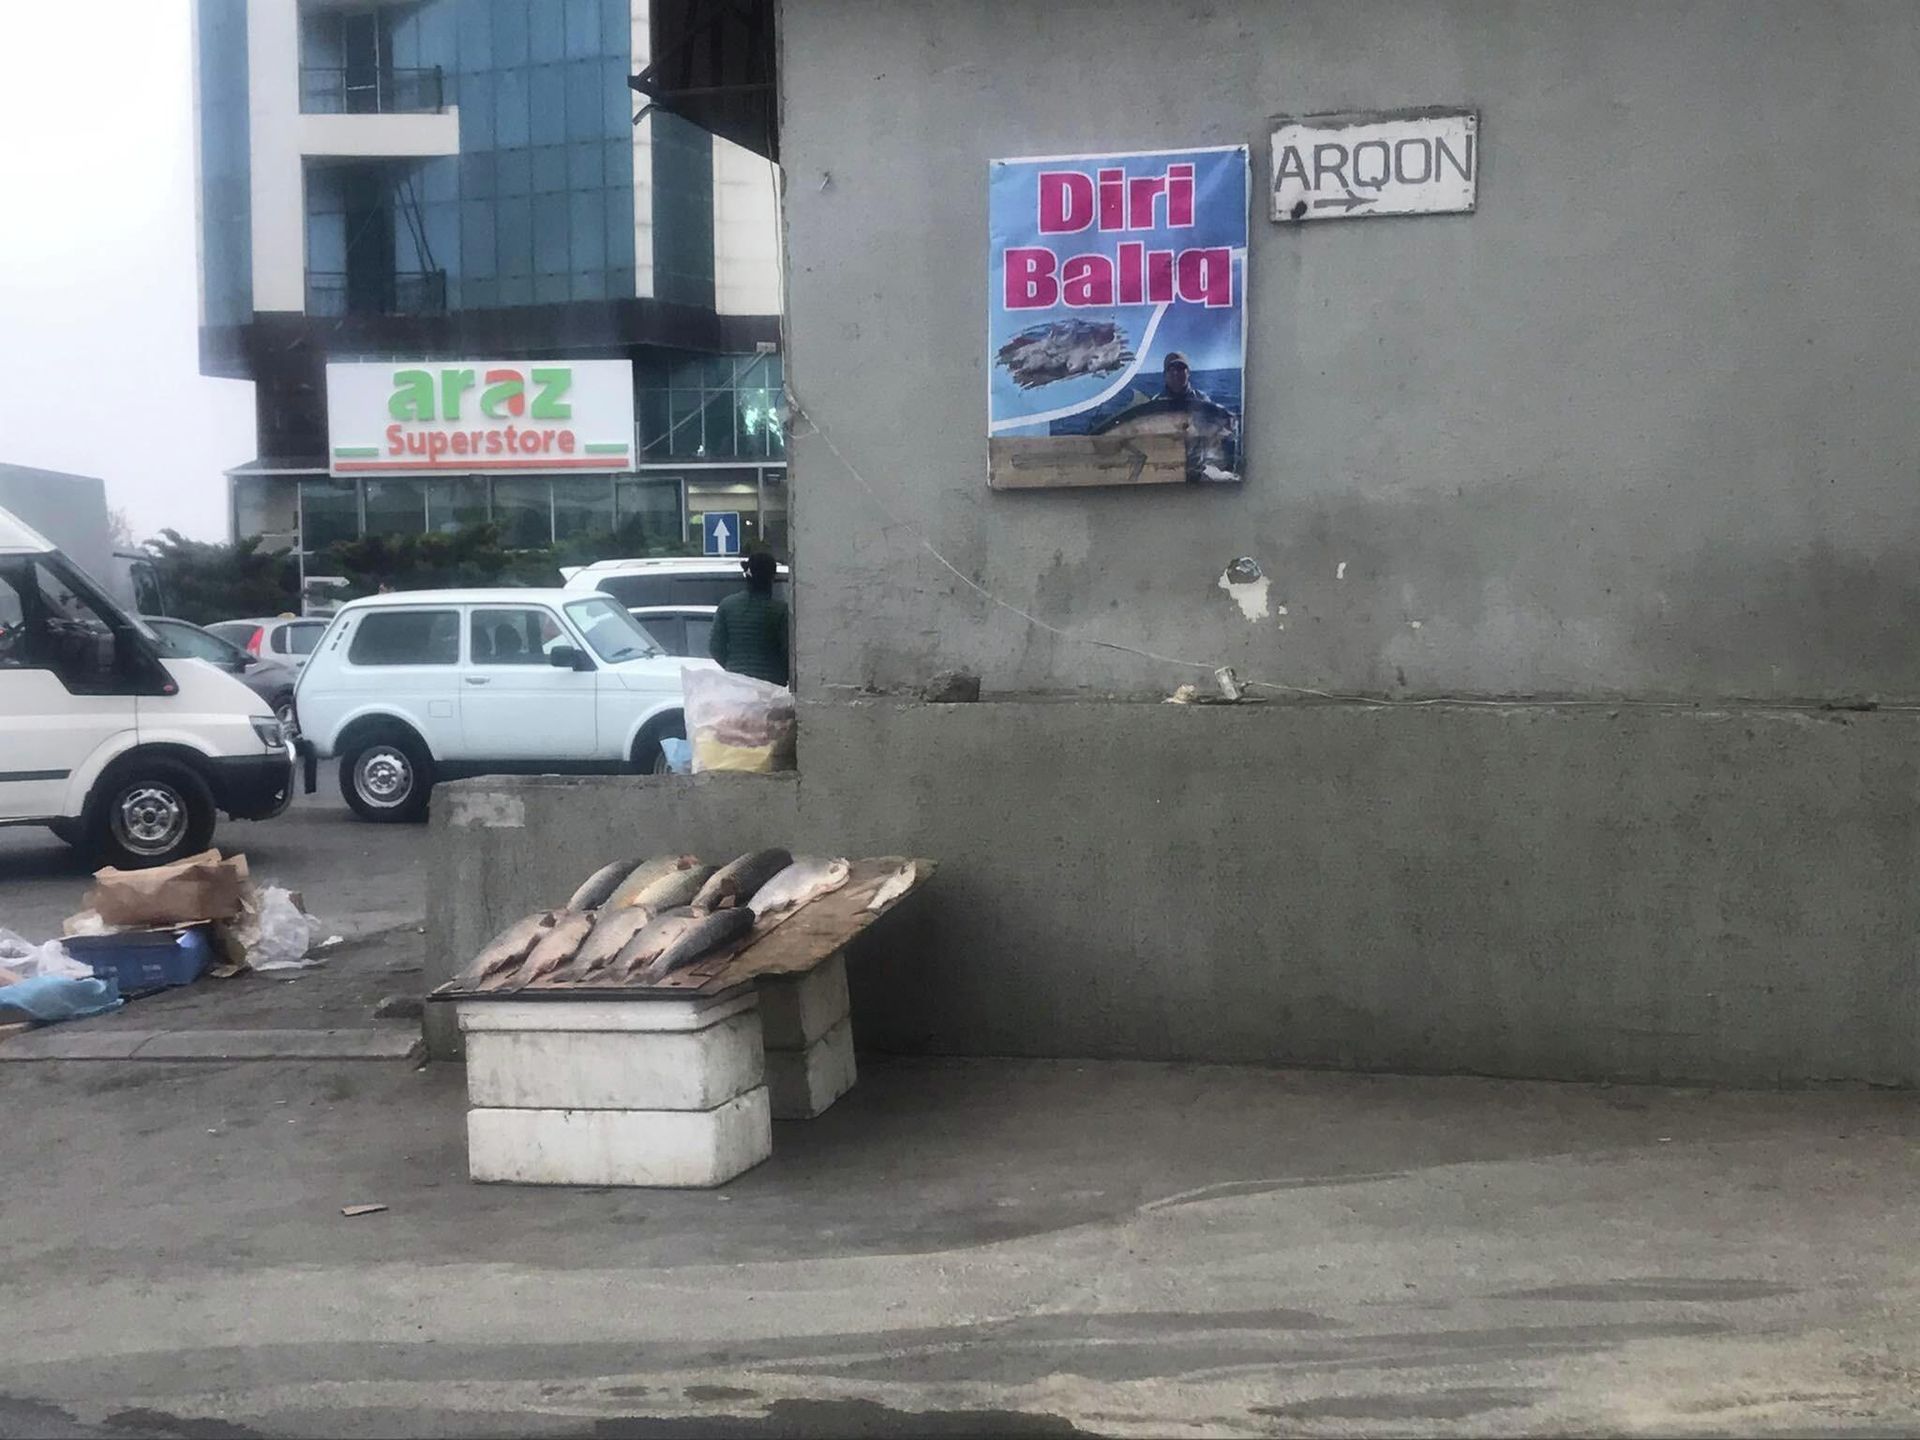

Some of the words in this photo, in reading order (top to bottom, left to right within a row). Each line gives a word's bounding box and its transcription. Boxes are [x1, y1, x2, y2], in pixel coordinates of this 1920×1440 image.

[1274, 134, 1473, 192] ARQON
[1038, 162, 1195, 235] Diri
[1003, 240, 1233, 311] Balıq
[388, 368, 572, 421] araz
[386, 424, 575, 462] Superstore
